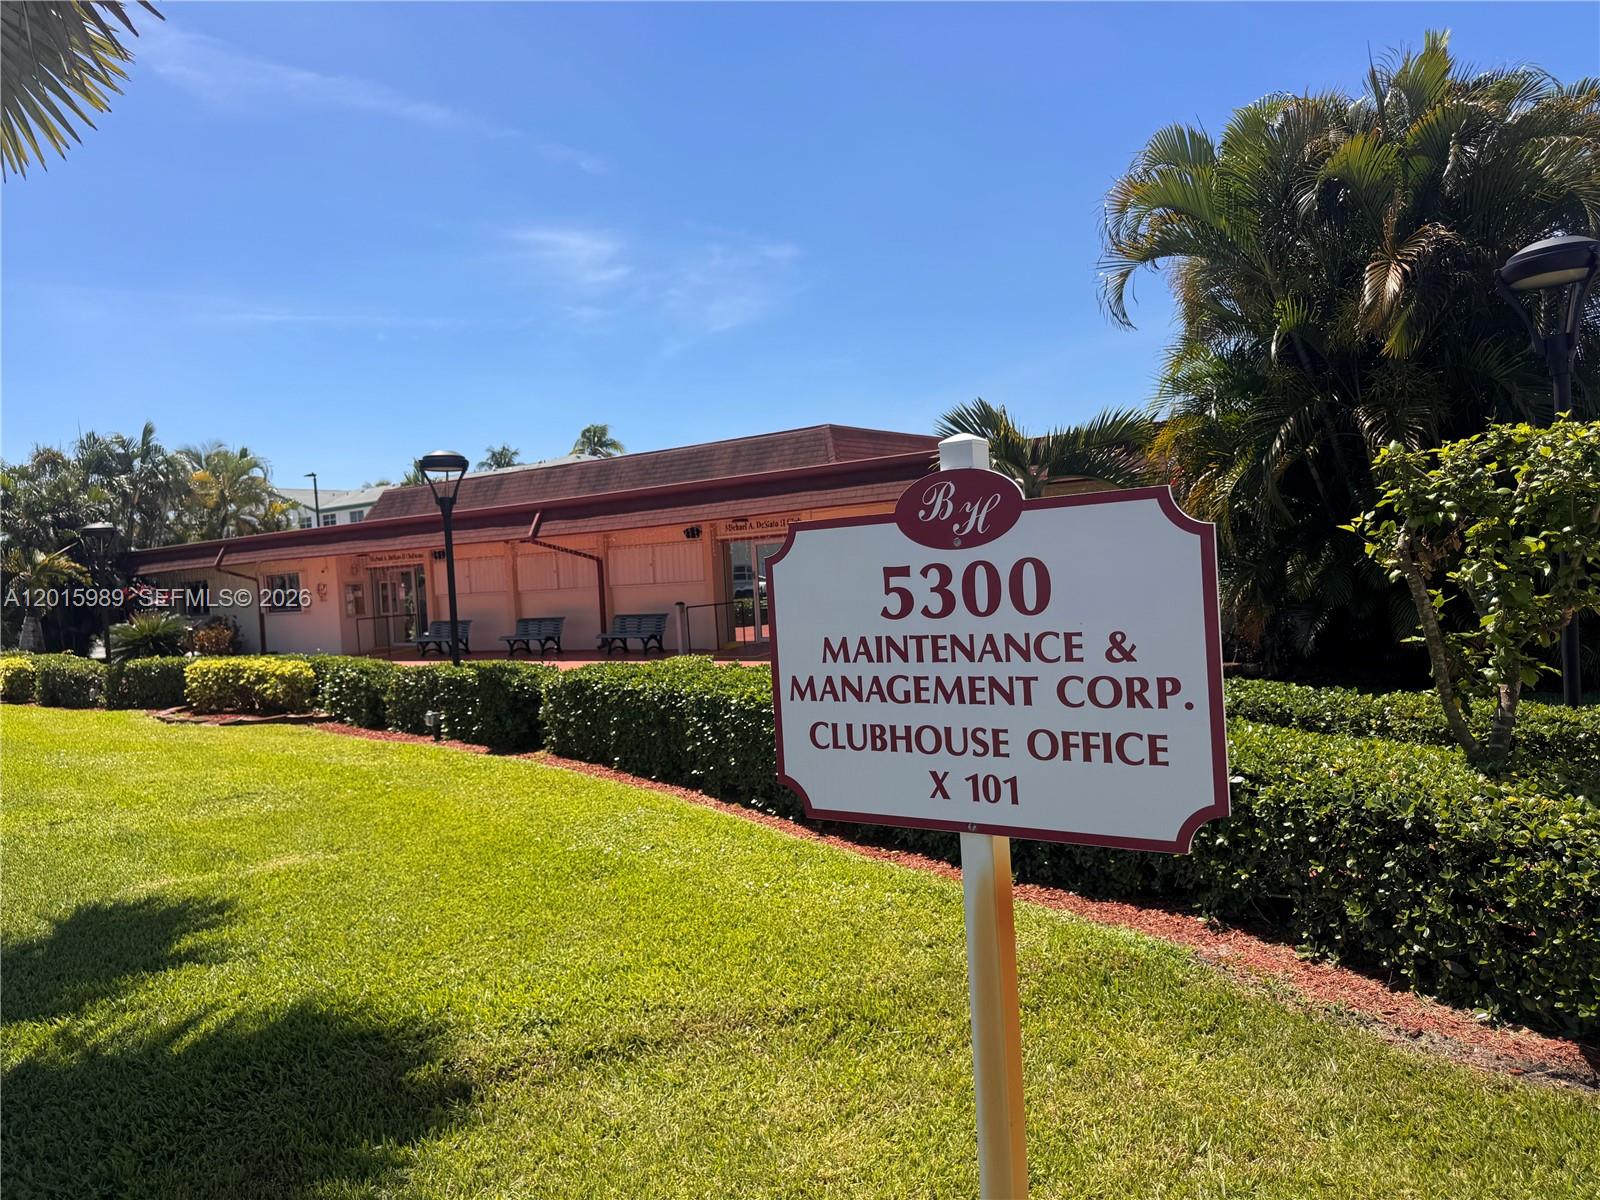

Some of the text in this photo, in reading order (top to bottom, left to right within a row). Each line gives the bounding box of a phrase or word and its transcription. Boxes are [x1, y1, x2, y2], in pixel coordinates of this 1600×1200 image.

[880, 556, 1052, 620] 5300
[822, 631, 1137, 664] MAINTENANCE &
[790, 675, 1195, 711] MANAGEMENT CORP.
[809, 721, 1170, 767] CLUBHOUSE OFFICE
[929, 771, 1019, 806] X 101
